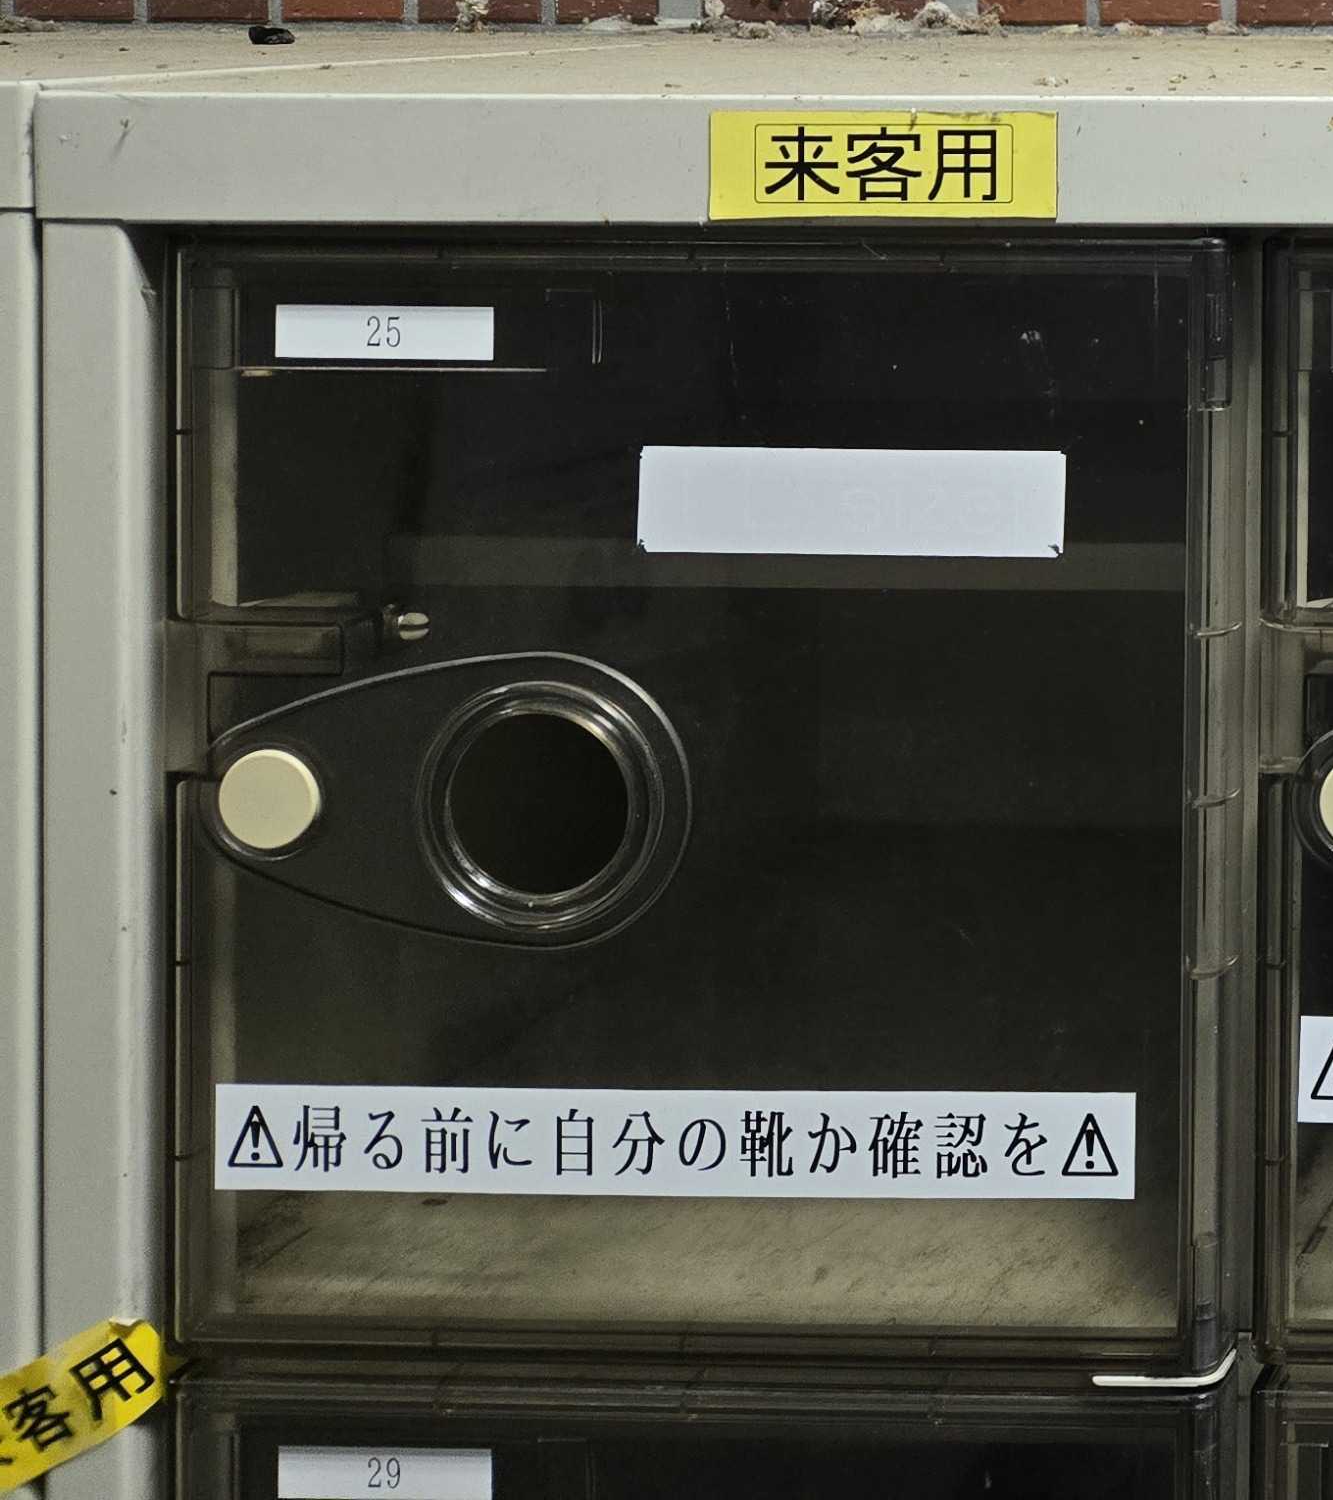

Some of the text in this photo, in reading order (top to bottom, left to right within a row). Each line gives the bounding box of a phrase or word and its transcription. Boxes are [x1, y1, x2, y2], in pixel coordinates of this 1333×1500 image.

[765, 127, 996, 200] 来客用
[367, 316, 400, 347] 25
[294, 1105, 1047, 1178] 帰る前に自分の靴か確認を
[0, 1338, 155, 1465] 客用
[368, 1457, 400, 1488] 29
